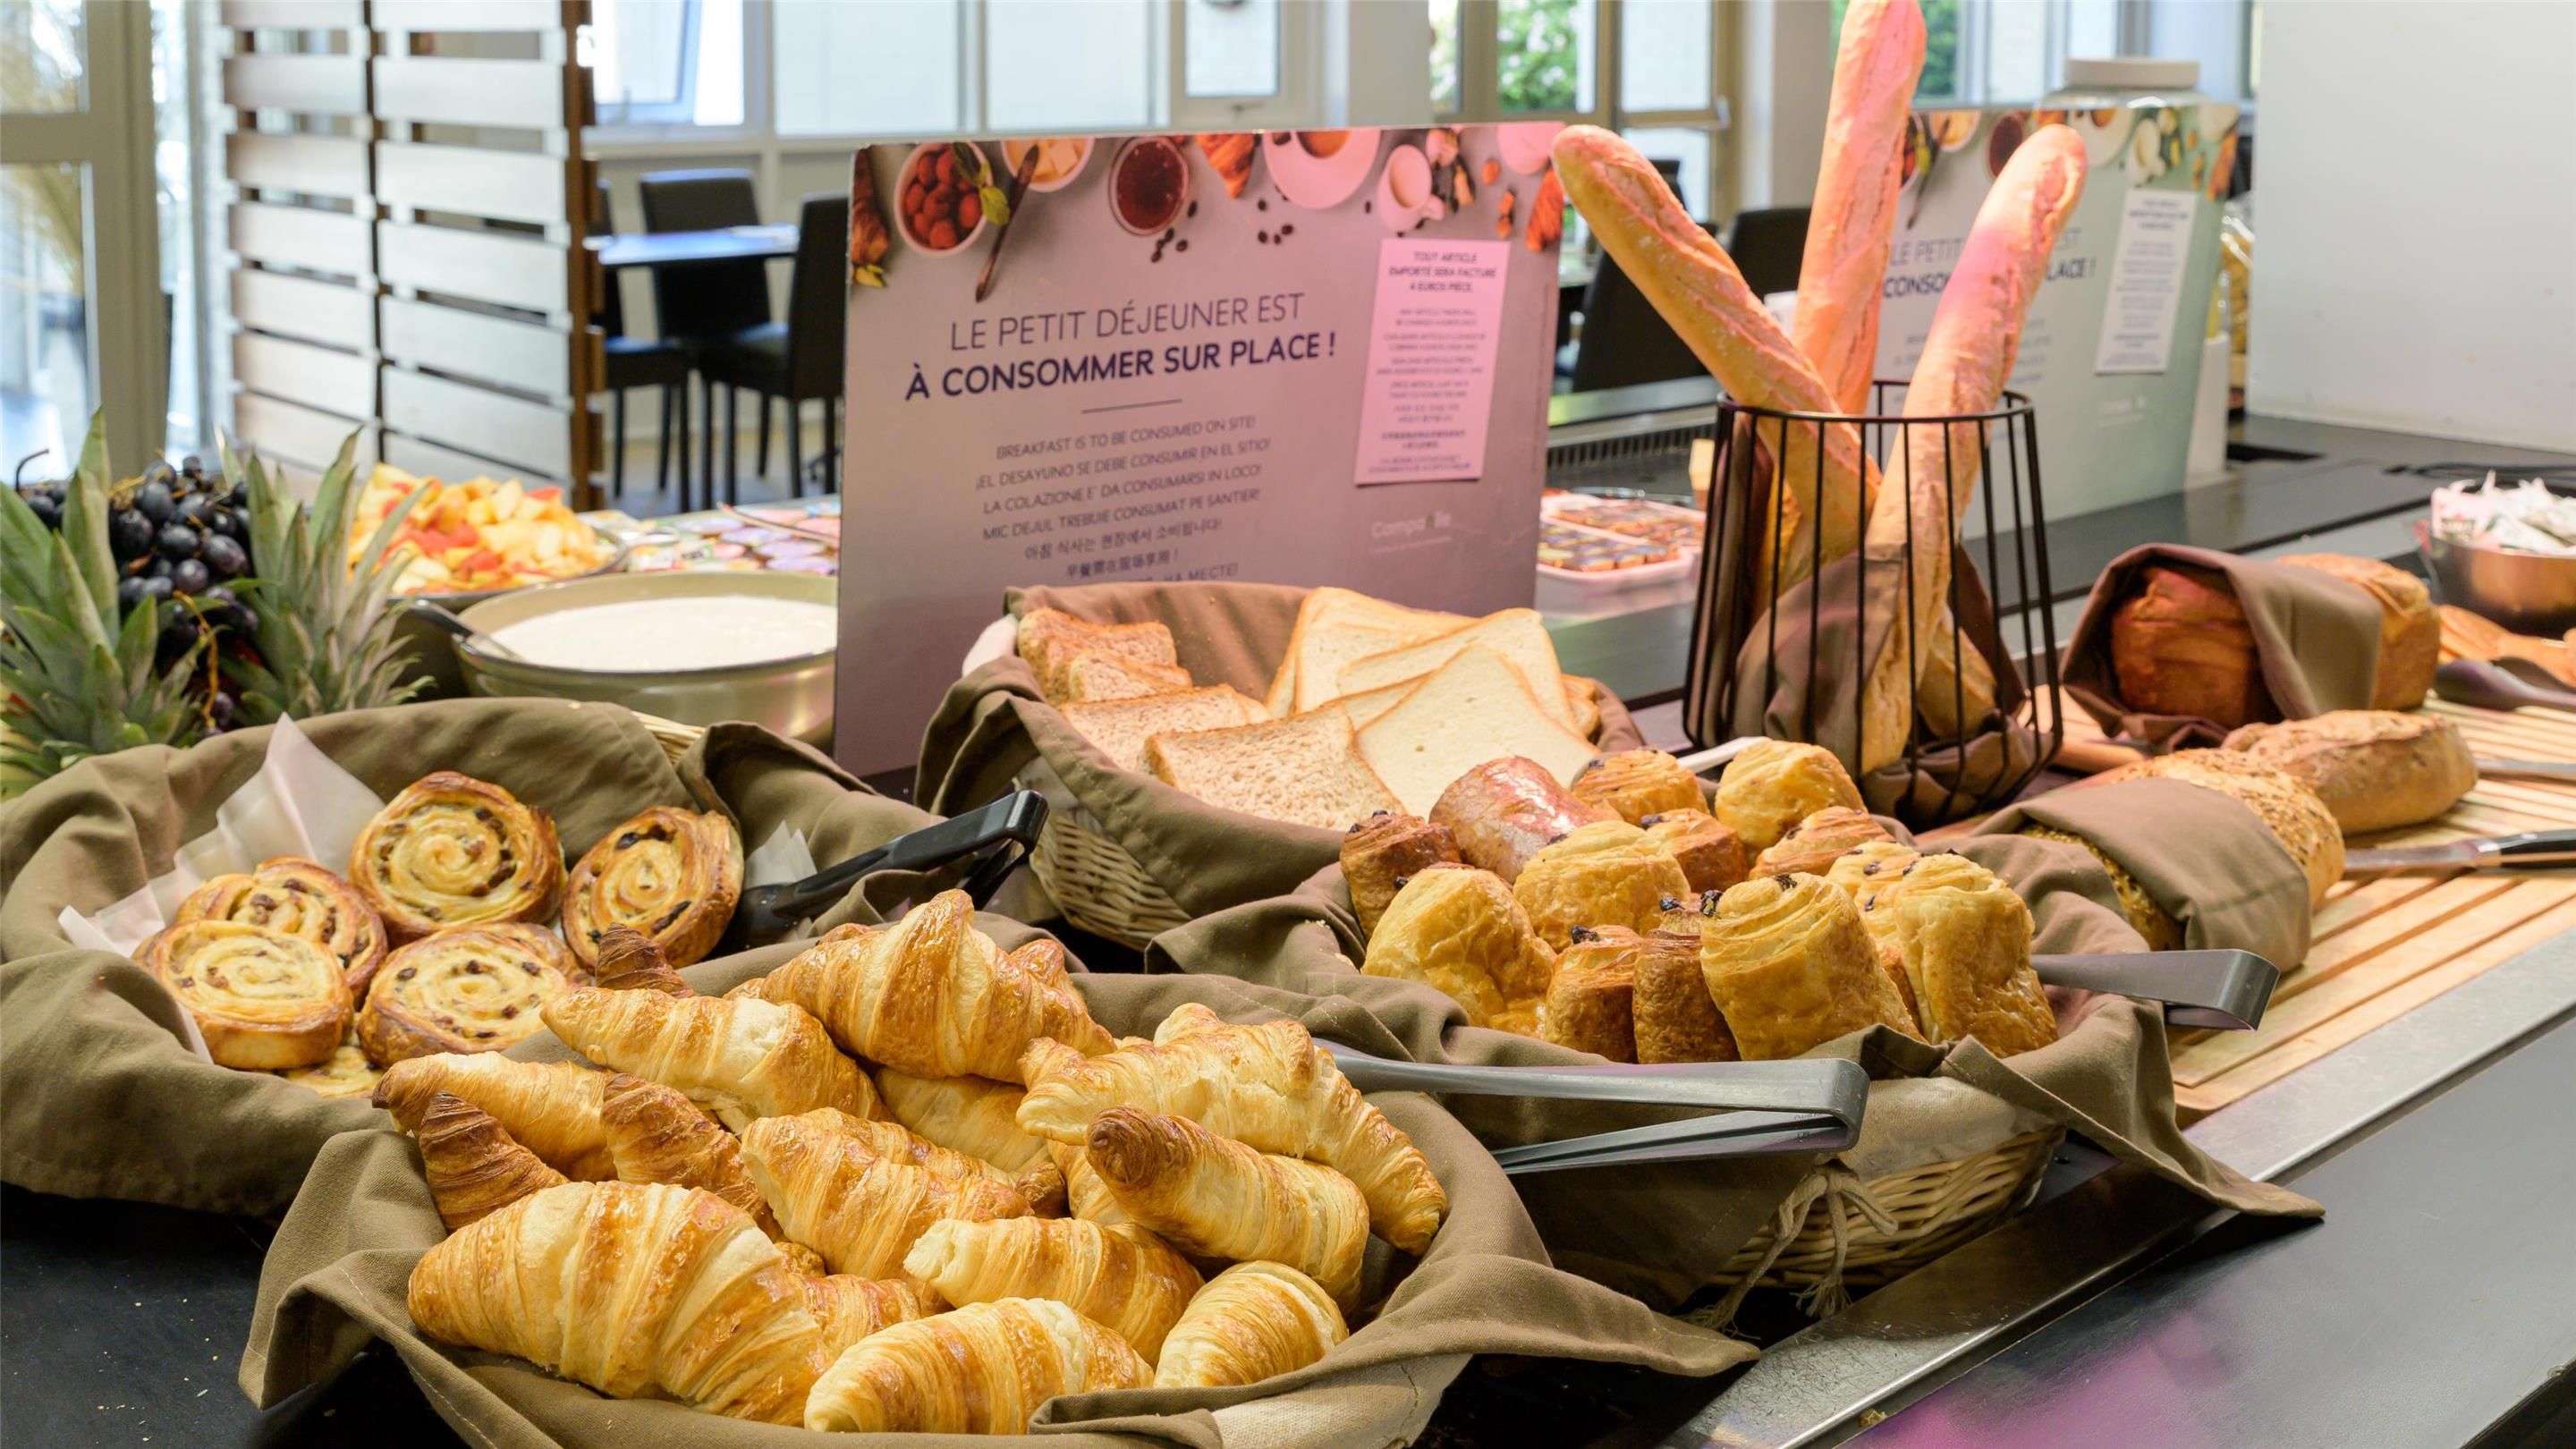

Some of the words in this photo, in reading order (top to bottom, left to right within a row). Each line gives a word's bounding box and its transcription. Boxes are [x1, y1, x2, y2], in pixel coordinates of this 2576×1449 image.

[1414, 251, 1438, 262] TOUT
[1441, 252, 1477, 264] ARTICLE
[1434, 267, 1455, 277] SERA
[1418, 282, 1446, 292] EUROS
[951, 319, 987, 351] LE
[998, 311, 1087, 347] PETIT
[1097, 299, 1249, 337] DÉJEUNER
[1258, 292, 1306, 324] EST
[905, 362, 930, 402] À
[942, 349, 1155, 396] CONSOMMER
[1164, 343, 1221, 374] SUR
[1230, 332, 1320, 368] PLACE
[1327, 331, 1336, 357] !
[996, 437, 1072, 460] BREAKFAST
[1074, 436, 1087, 450] IS
[1089, 433, 1108, 447] TO
[1112, 430, 1127, 445] BE
[1130, 422, 1202, 443] CONSUMED
[1206, 419, 1225, 434] ON
[1228, 415, 1256, 431] SITE!
[999, 463, 1074, 487] DESAYUNO
[1077, 461, 1090, 475] SE
[1095, 456, 1126, 473] DEBE
[1131, 447, 1198, 469] CONSUMIR
[1201, 445, 1217, 459] EN
[1221, 443, 1233, 457] EL
[1237, 437, 1271, 453] SITIO!
[984, 500, 1002, 514] LA
[1005, 487, 1083, 511] COLAZIONE
[1100, 482, 1120, 497] DA
[1123, 471, 1205, 494] CONSUMARSI
[1208, 469, 1222, 482] IN
[983, 525, 1007, 540] MIC
[1013, 519, 1053, 537] DEJUL
[1059, 510, 1110, 529] TREBUIE
[1114, 497, 1186, 521] CONSUMAT
[1189, 496, 1203, 510] PE
[1025, 542, 1053, 560] 아침
[1058, 538, 1096, 555] 식사는
[1102, 528, 1152, 550] 현장에서
